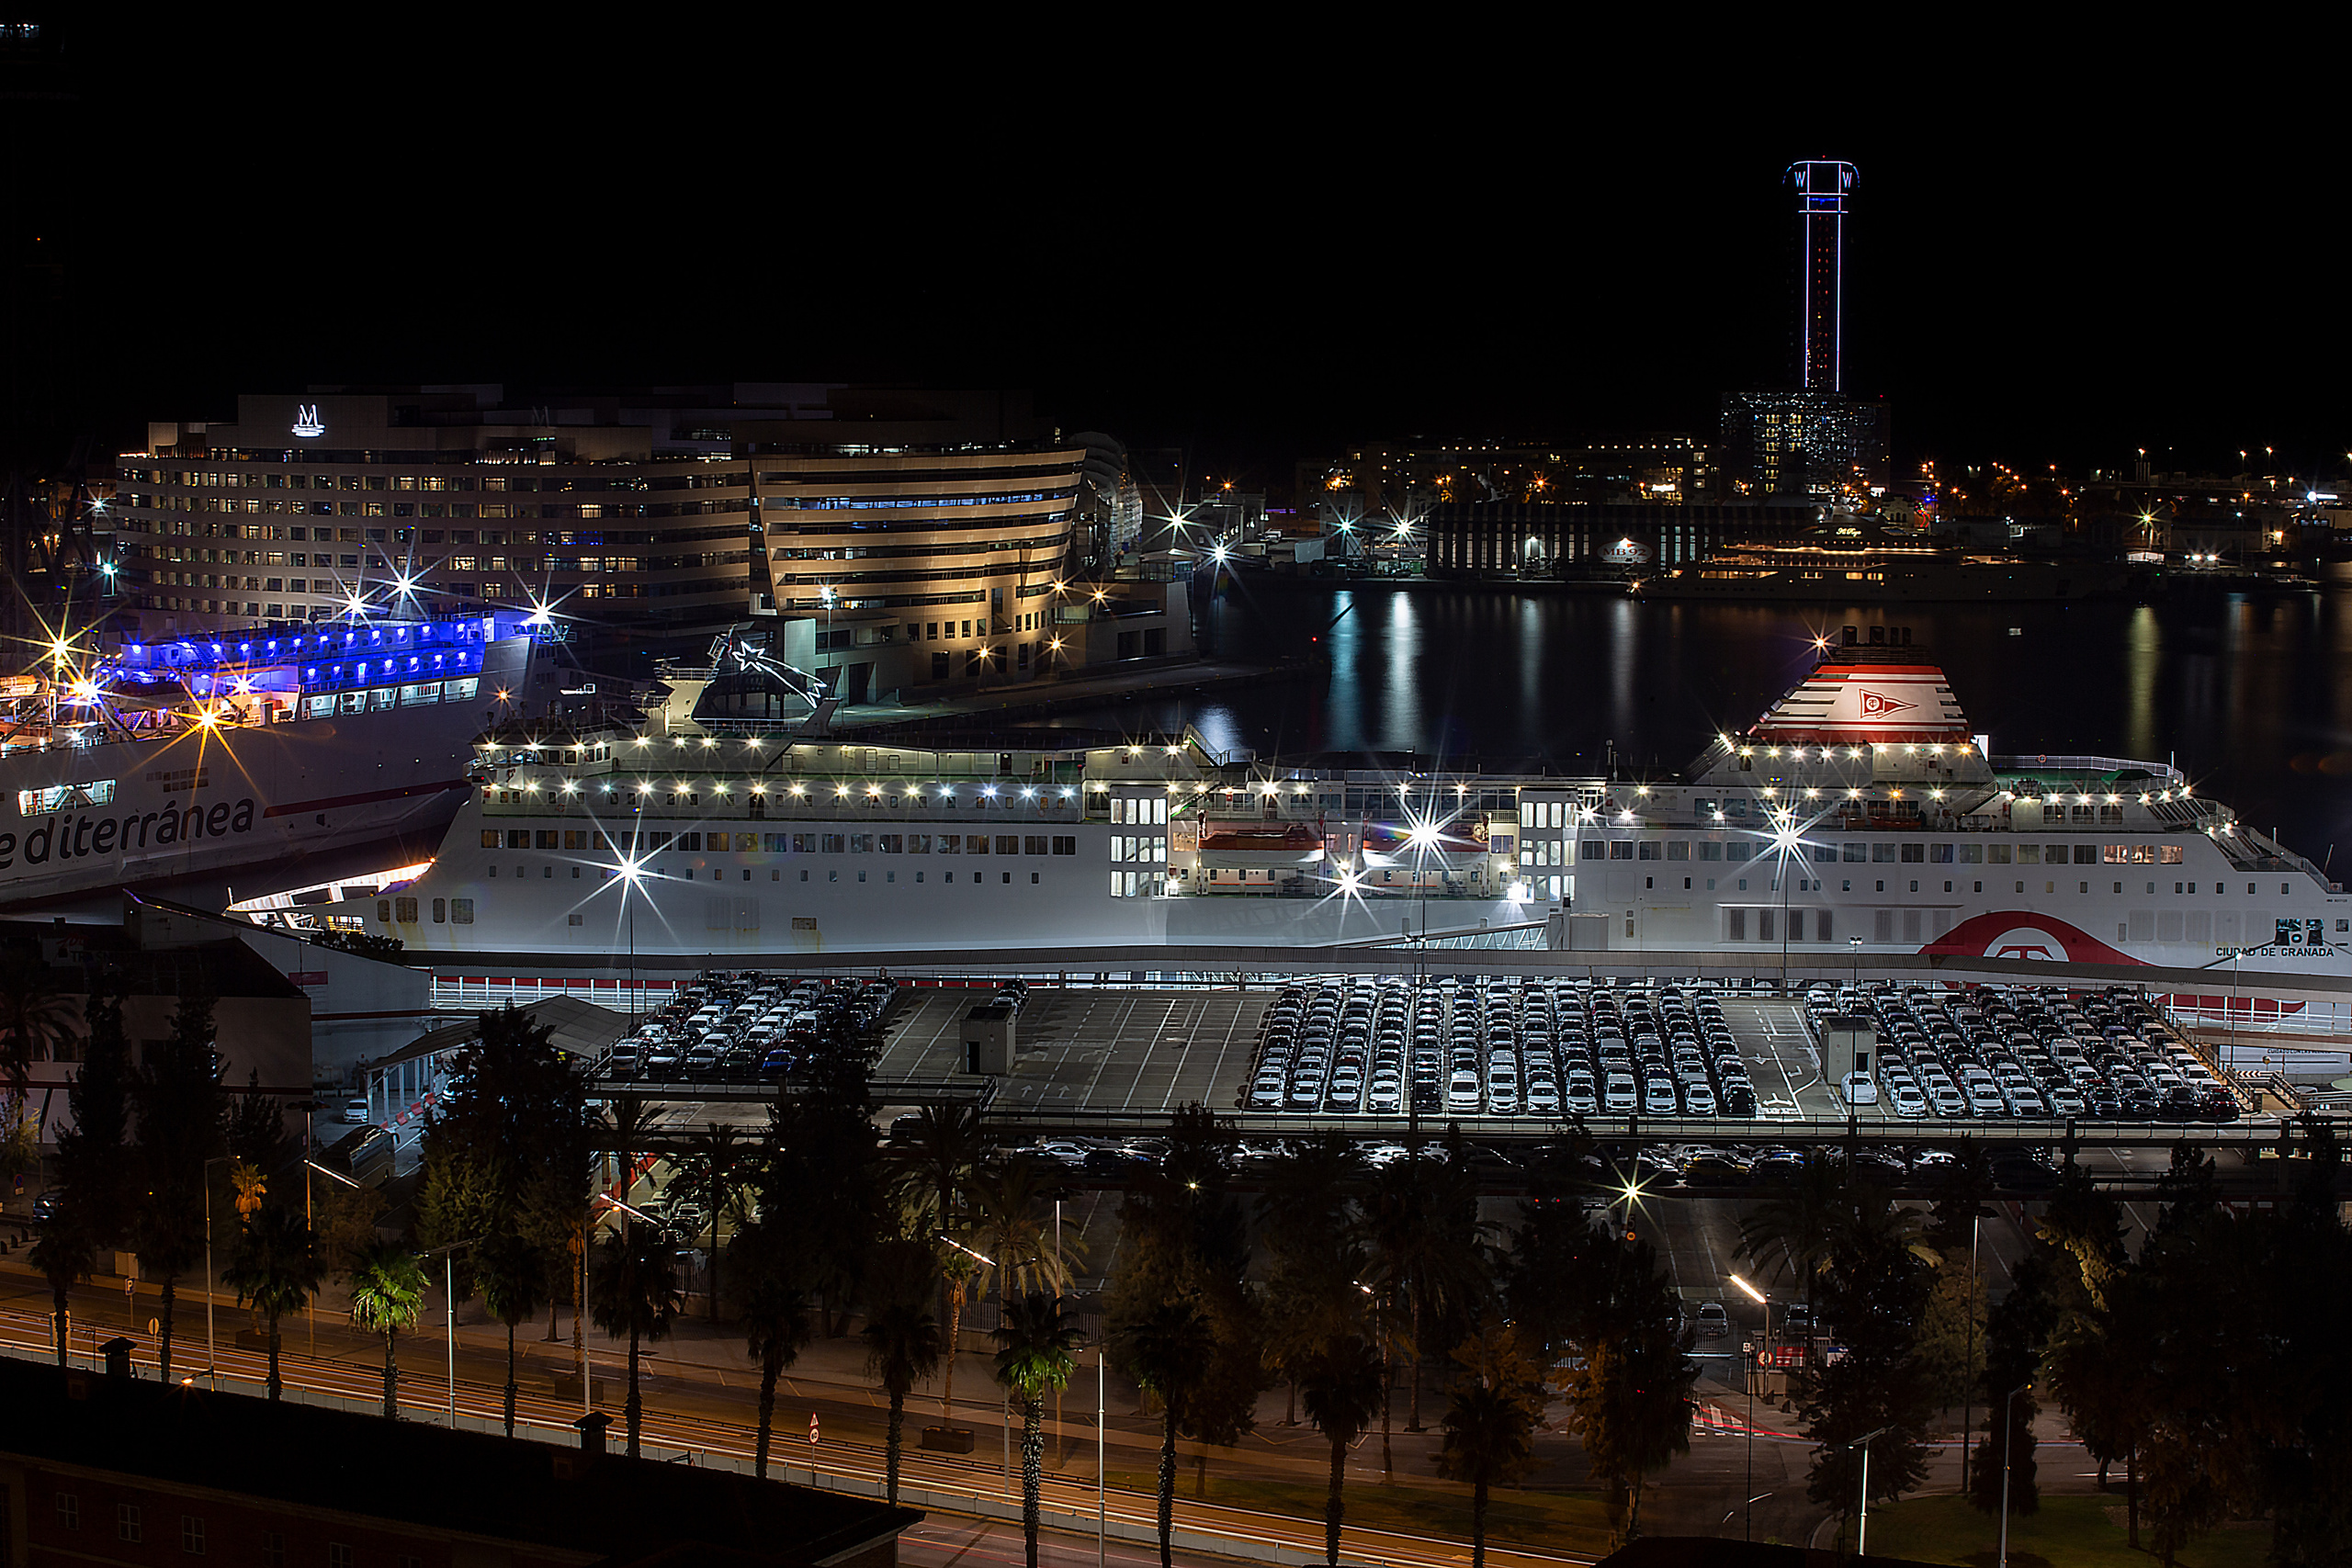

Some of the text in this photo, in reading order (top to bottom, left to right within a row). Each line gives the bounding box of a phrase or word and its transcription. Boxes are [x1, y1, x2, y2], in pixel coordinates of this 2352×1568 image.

[1794, 171, 1806, 187] W
[1842, 171, 1852, 188] W
[1603, 547, 1626, 556] MB
[2216, 947, 2335, 956] CIUDAD DE GRANADA
[127, 1280, 133, 1292] P
